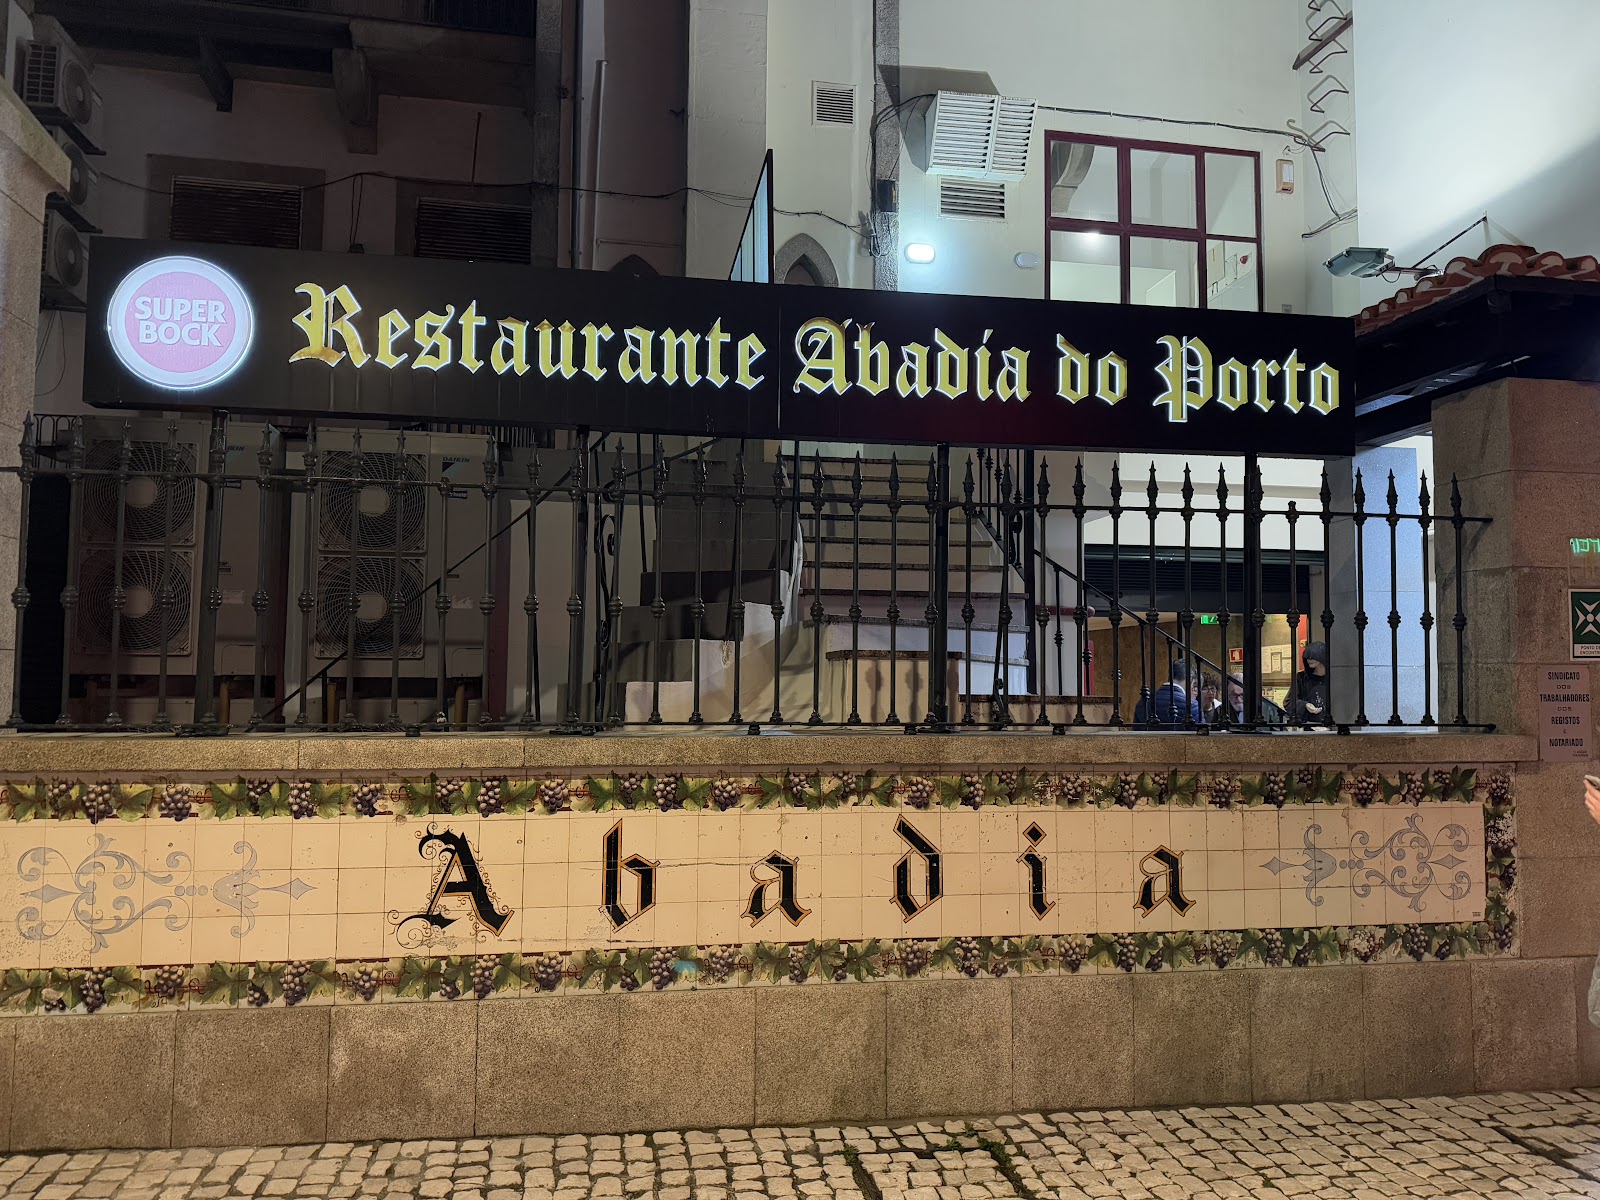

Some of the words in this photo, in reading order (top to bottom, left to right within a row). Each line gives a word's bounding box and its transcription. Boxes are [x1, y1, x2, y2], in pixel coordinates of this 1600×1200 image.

[134, 296, 227, 324] SUPER
[138, 320, 224, 347] BOCK
[288, 282, 767, 391] Restaurante
[1055, 332, 1129, 405] do
[1151, 334, 1340, 424] Porto
[1547, 671, 1580, 680] SINDICATO
[1539, 693, 1590, 702] TRABALHADORES
[1551, 716, 1581, 725] REGISTOS
[1549, 738, 1584, 747] NOTARIADO
[386, 813, 1197, 949] Abadia
